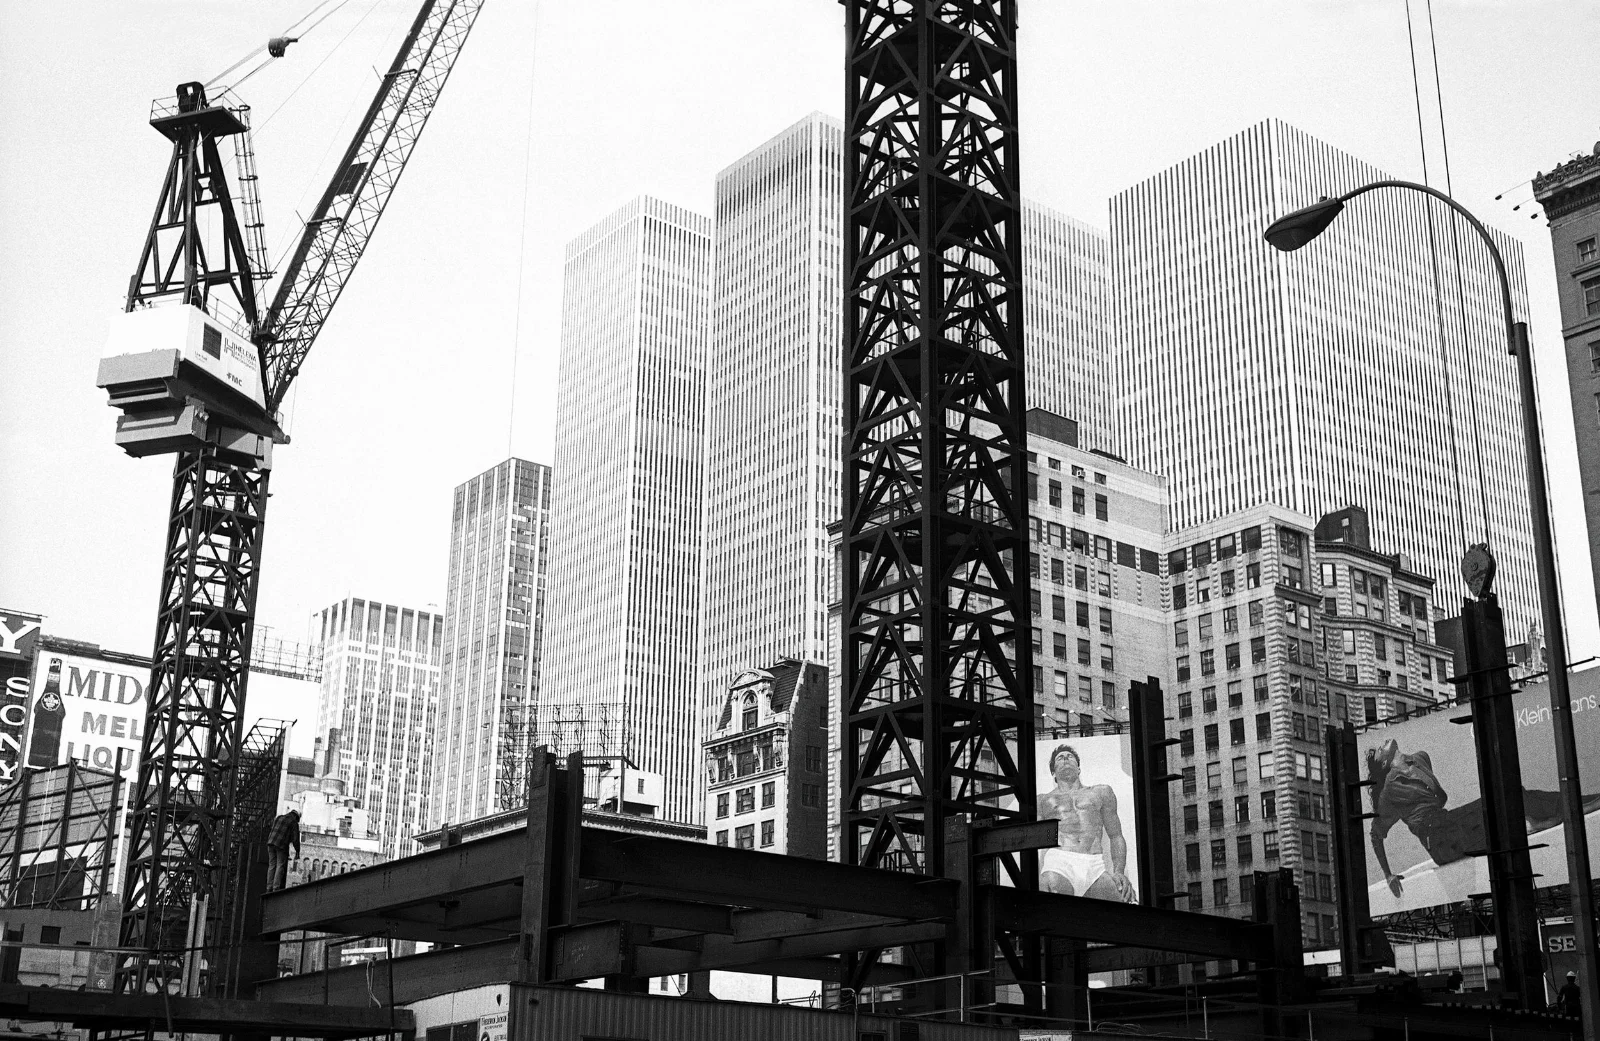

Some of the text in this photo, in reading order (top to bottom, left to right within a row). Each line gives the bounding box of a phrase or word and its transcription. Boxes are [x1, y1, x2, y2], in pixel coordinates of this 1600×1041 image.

[0, 676, 31, 780] SONY
[1516, 693, 1597, 728] Klein ans
